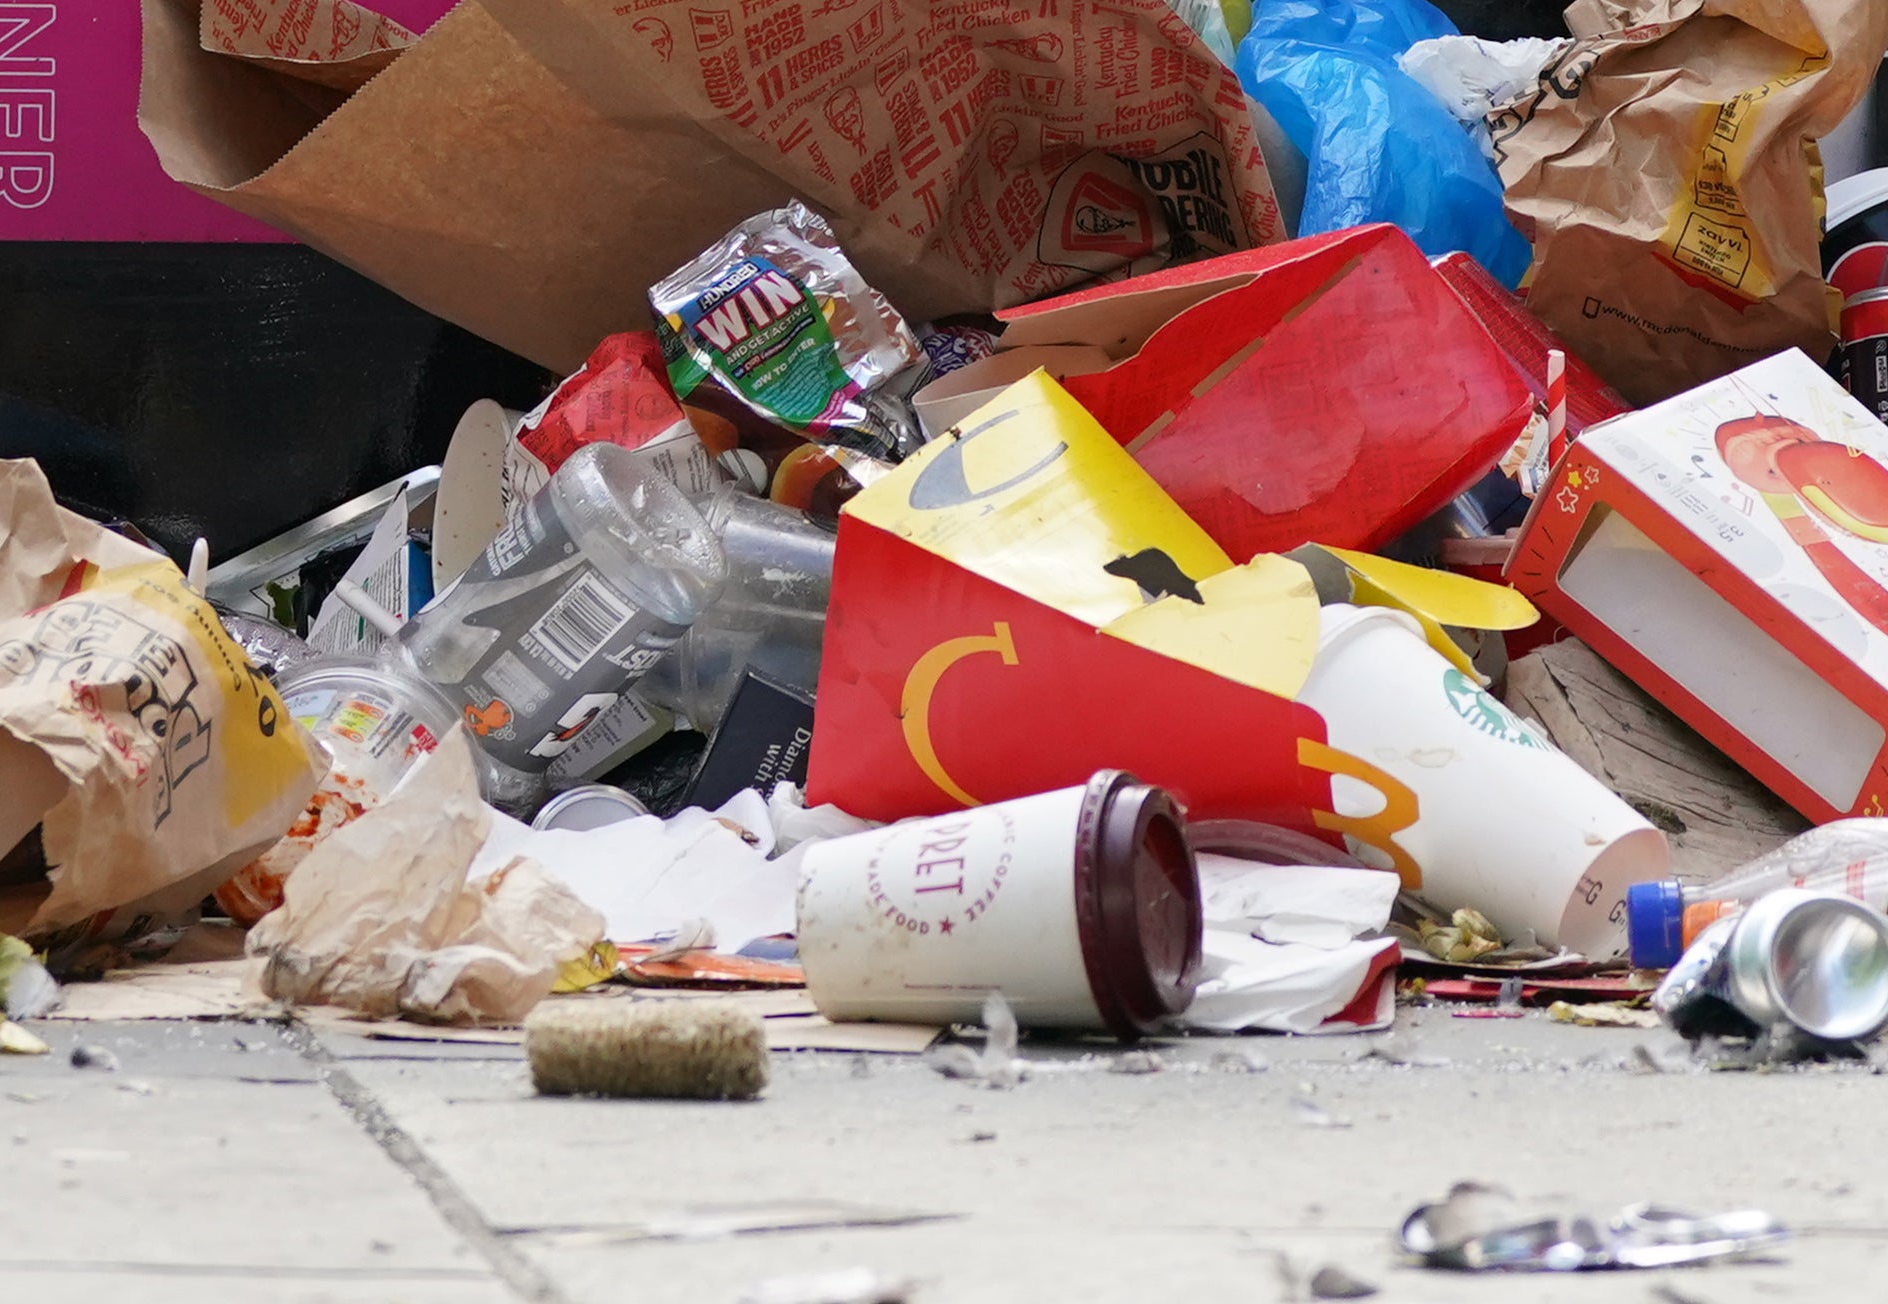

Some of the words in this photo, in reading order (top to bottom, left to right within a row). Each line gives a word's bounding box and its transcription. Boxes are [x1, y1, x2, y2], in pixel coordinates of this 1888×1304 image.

[744, 4, 801, 36] HAND
[916, 18, 956, 49] Fried
[962, 10, 1031, 30] Chicken
[930, 0, 1010, 24] Kentucky
[746, 14, 803, 49] MADE
[762, 28, 806, 61] 1952
[786, 35, 843, 72] HERBS
[799, 52, 844, 84] SPICES
[1095, 24, 1114, 91] Kentucky
[1150, 47, 1165, 89] HAND
[1116, 64, 1140, 99] Fried
[1115, 93, 1194, 122] Kentucky
[1096, 118, 1142, 141] Fried
[1698, 226, 1743, 253] zavvi
[700, 263, 759, 309] HUNDRED
[696, 270, 804, 353] WIN
[727, 345, 748, 366] AND
[749, 334, 771, 353] GET
[767, 304, 810, 340] ACTIVE
[773, 360, 787, 377] TO
[788, 338, 816, 367] ENTER
[755, 745, 781, 782] with
[771, 727, 812, 786] Diamo
[915, 821, 971, 896] PRET
[868, 858, 887, 905] MADE
[885, 905, 929, 934] FOOD
[965, 853, 1012, 921] COFFEE
